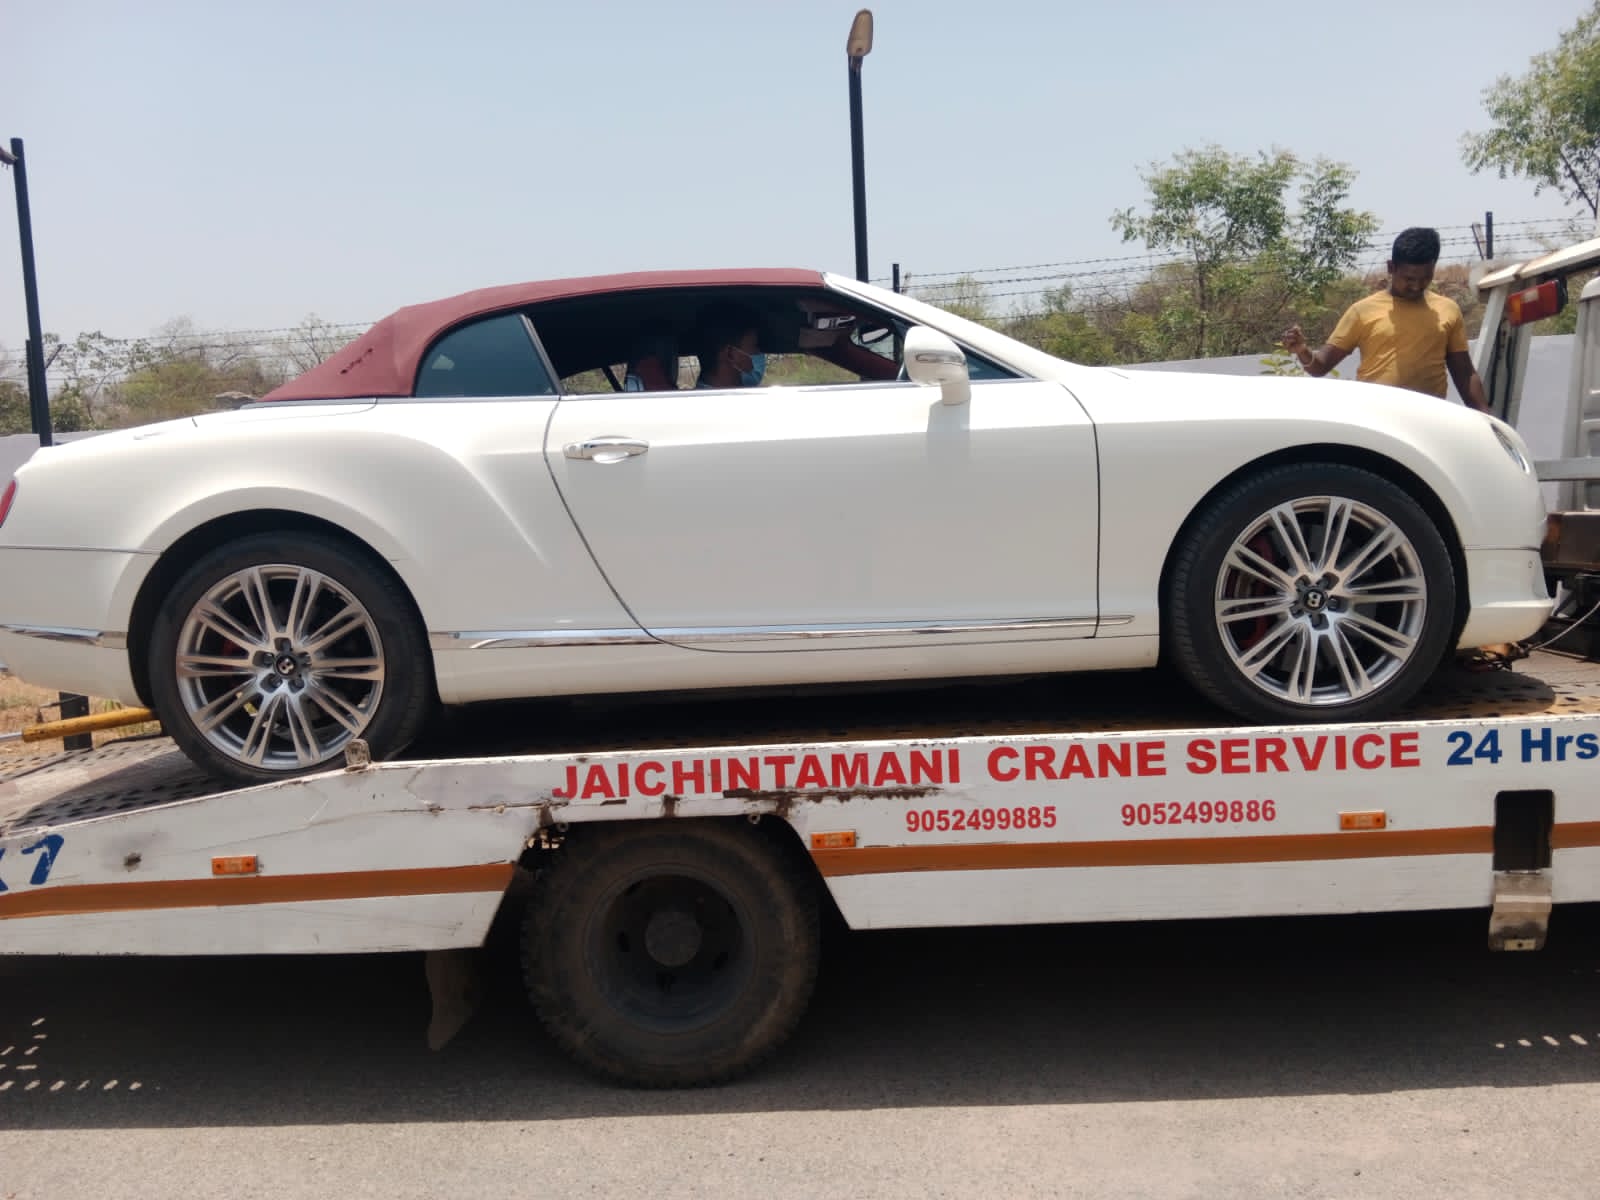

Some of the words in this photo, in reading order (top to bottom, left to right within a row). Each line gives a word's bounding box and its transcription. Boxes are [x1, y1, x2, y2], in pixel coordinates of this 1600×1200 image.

[552, 748, 961, 800] JAICHINTAMANI
[987, 740, 1168, 783] CRANE
[1186, 732, 1421, 775] SERVICE
[1447, 729, 1503, 765] 24
[1521, 727, 1599, 763] Hrs
[905, 805, 1057, 833] 9052499885
[1121, 799, 1277, 827] 9052499886
